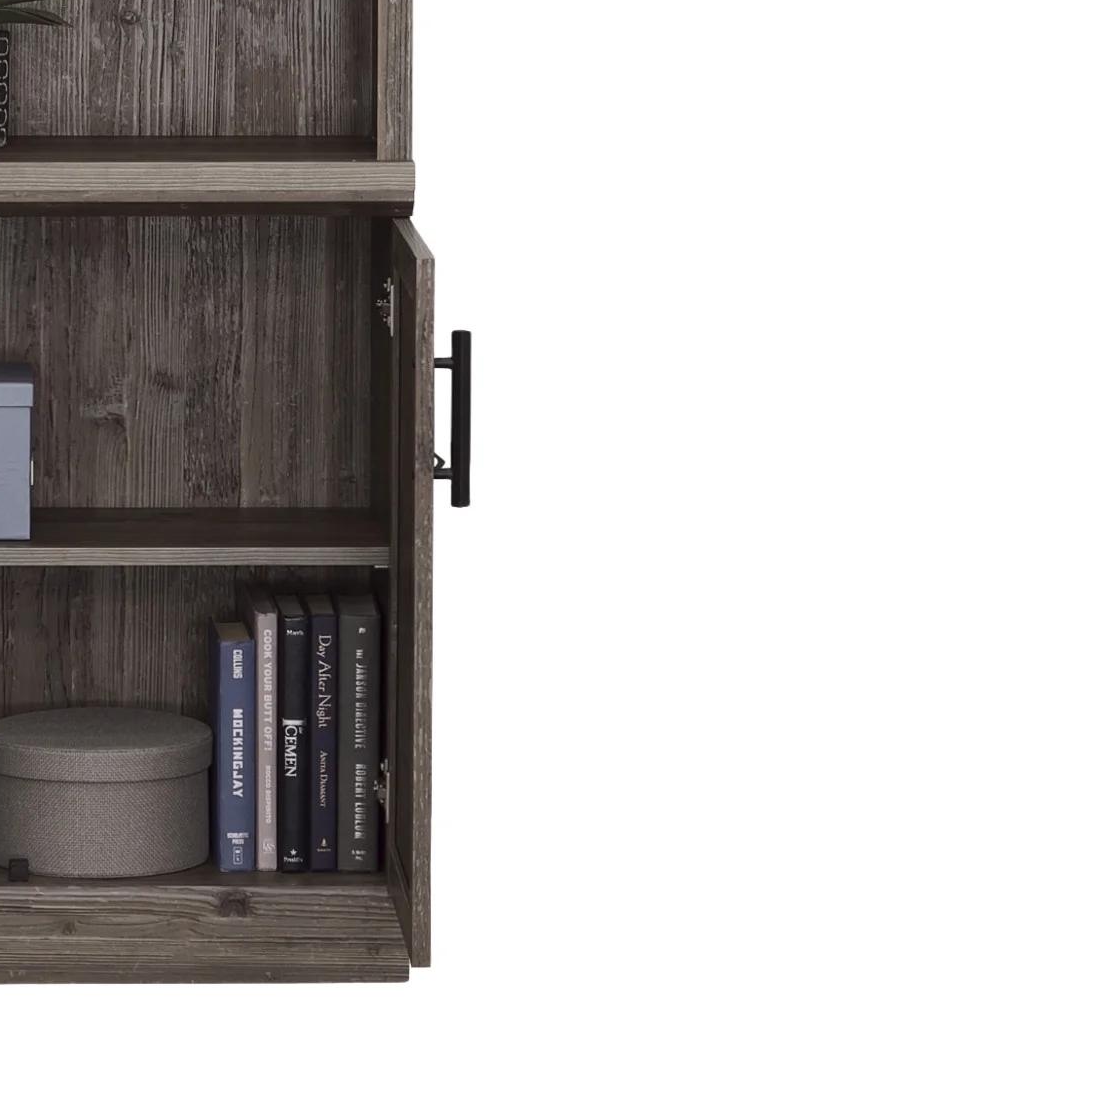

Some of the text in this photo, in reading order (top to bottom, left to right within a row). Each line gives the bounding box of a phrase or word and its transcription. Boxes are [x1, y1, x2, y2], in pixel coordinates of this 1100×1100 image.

[233, 650, 243, 679] COLLINS
[317, 635, 331, 727] Day After Night
[355, 663, 366, 698] JANSON
[263, 629, 272, 751] COOK YOUR BUTT OFF!
[232, 709, 243, 797] MOCKINGJAY
[282, 718, 306, 777] ICEMEN
[319, 751, 328, 772] ANITA
[355, 764, 367, 798] ROBERT
